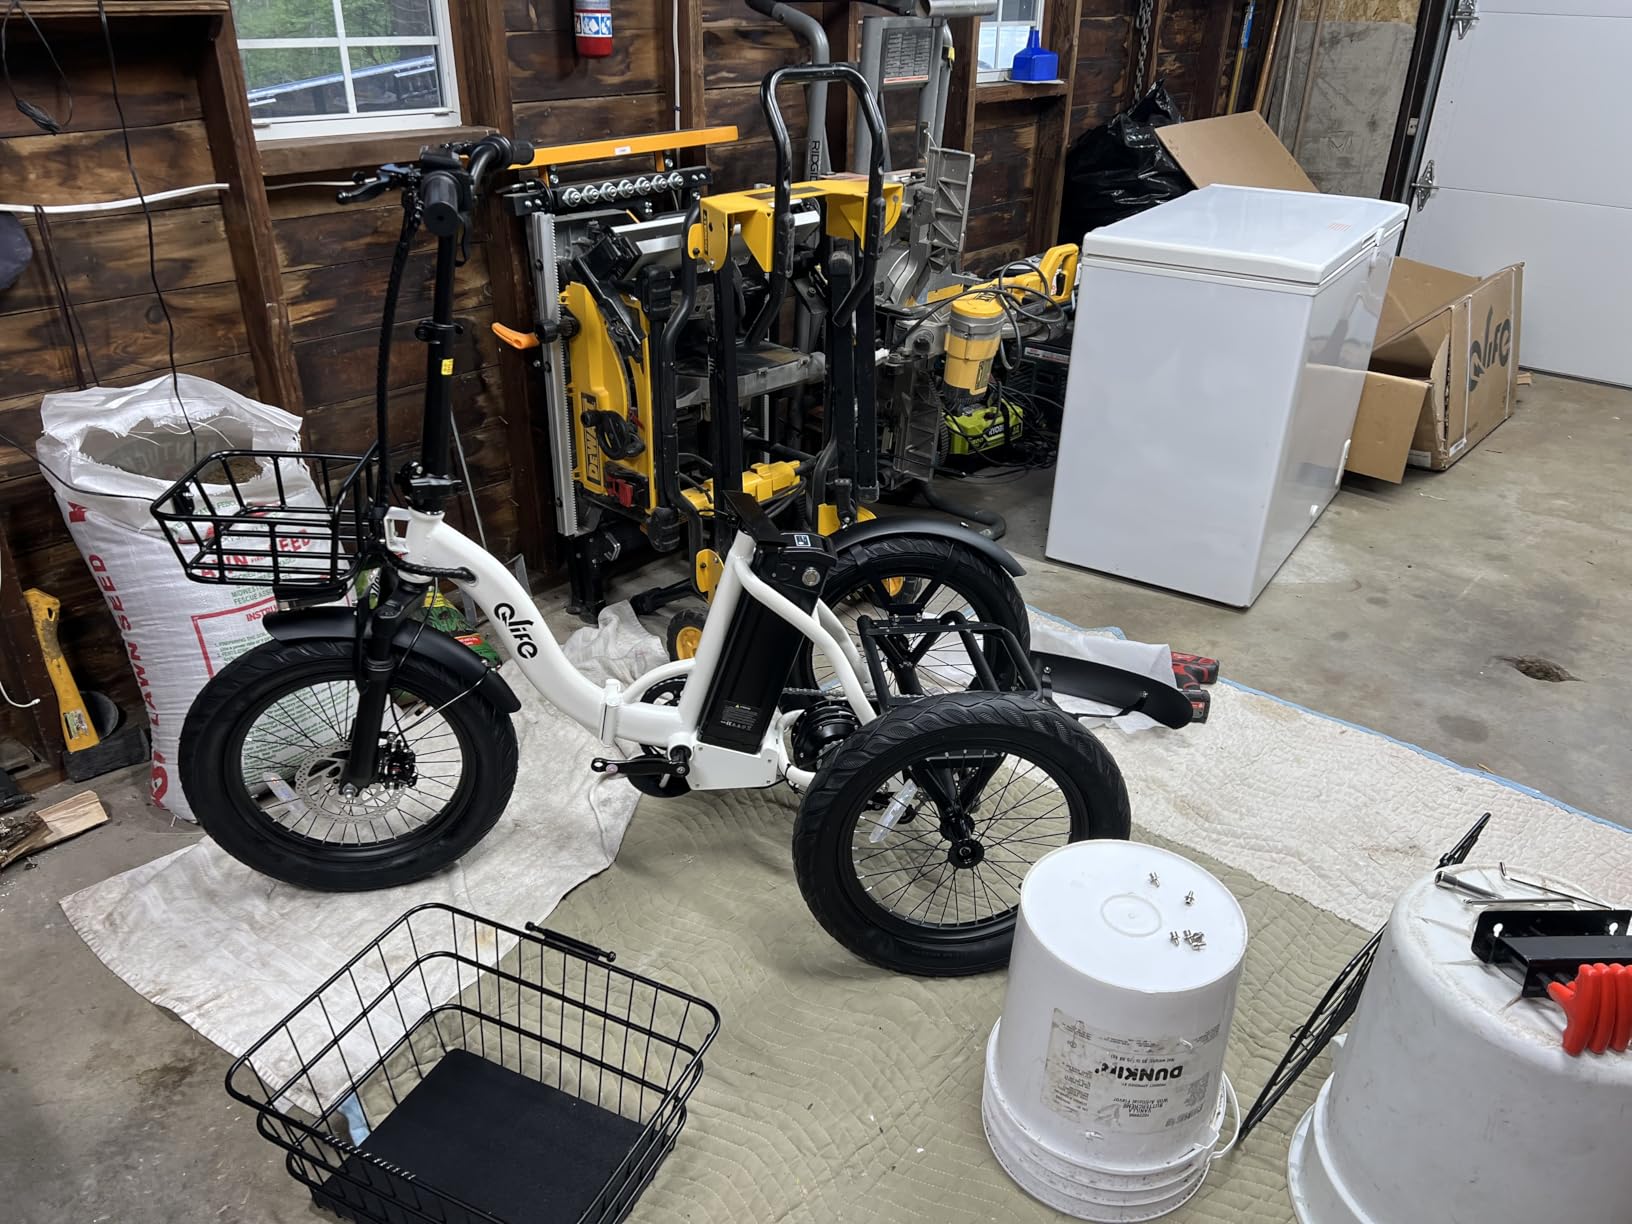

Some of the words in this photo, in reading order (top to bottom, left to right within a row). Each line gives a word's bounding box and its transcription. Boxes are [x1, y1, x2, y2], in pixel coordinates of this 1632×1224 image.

[582, 398, 600, 481] DEWAT
[89, 554, 132, 631] SEED
[127, 642, 159, 726] LAWN
